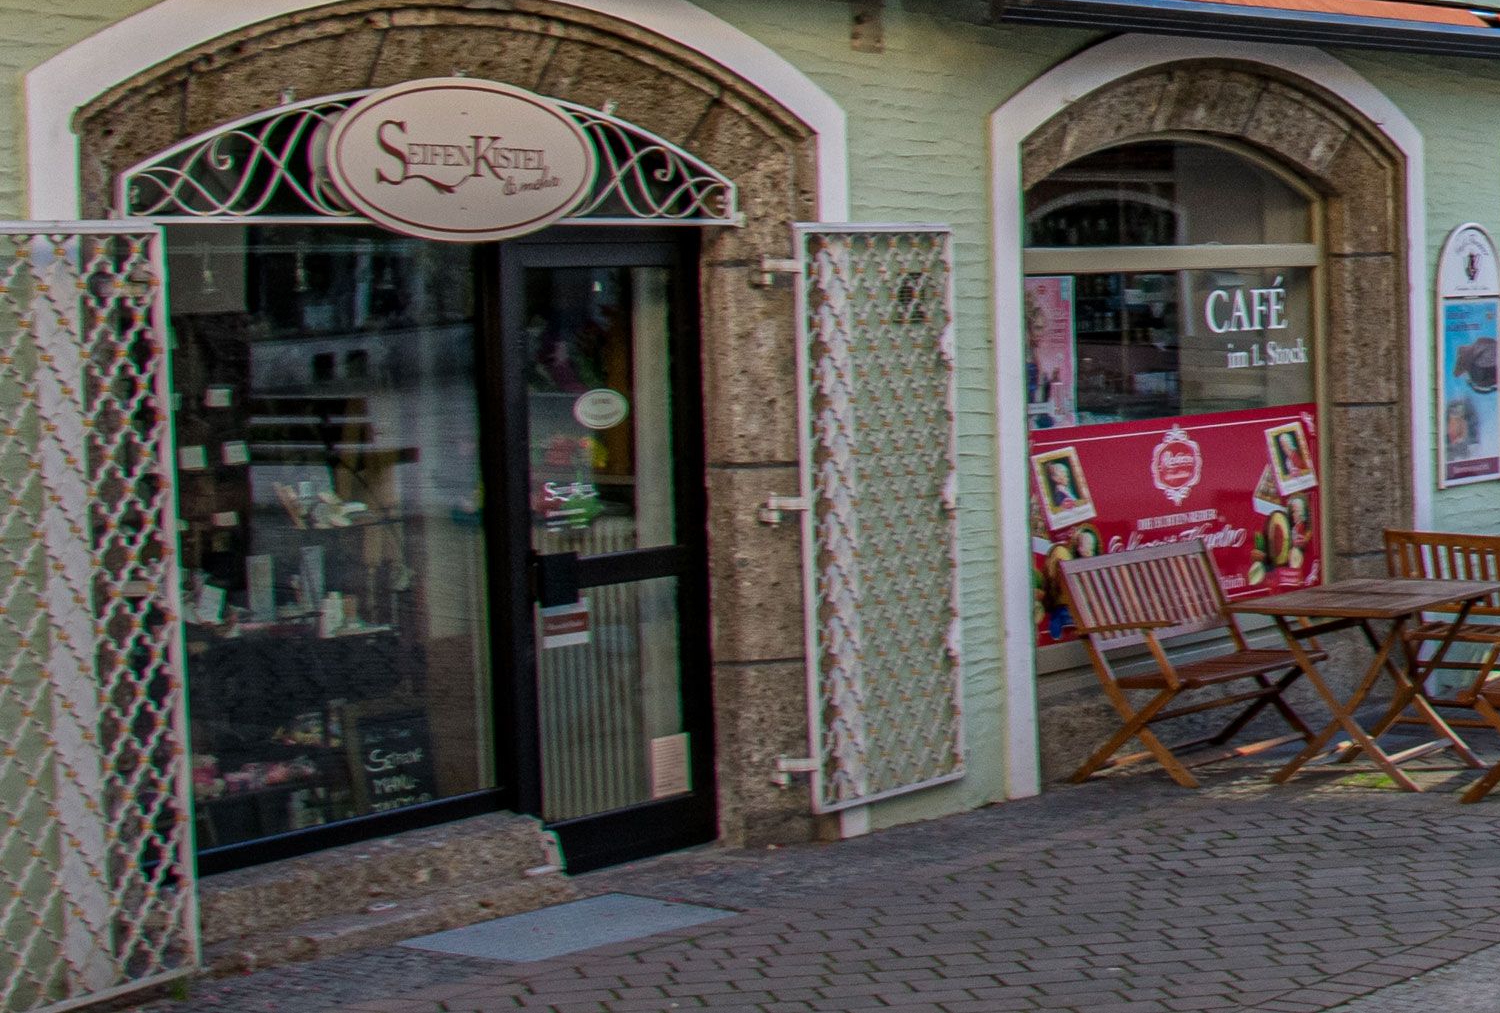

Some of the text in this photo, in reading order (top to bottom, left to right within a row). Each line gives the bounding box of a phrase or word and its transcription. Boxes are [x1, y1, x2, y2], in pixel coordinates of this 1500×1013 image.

[1205, 275, 1289, 333] CAFÉ
[1227, 338, 1308, 368] im 1. Stock
